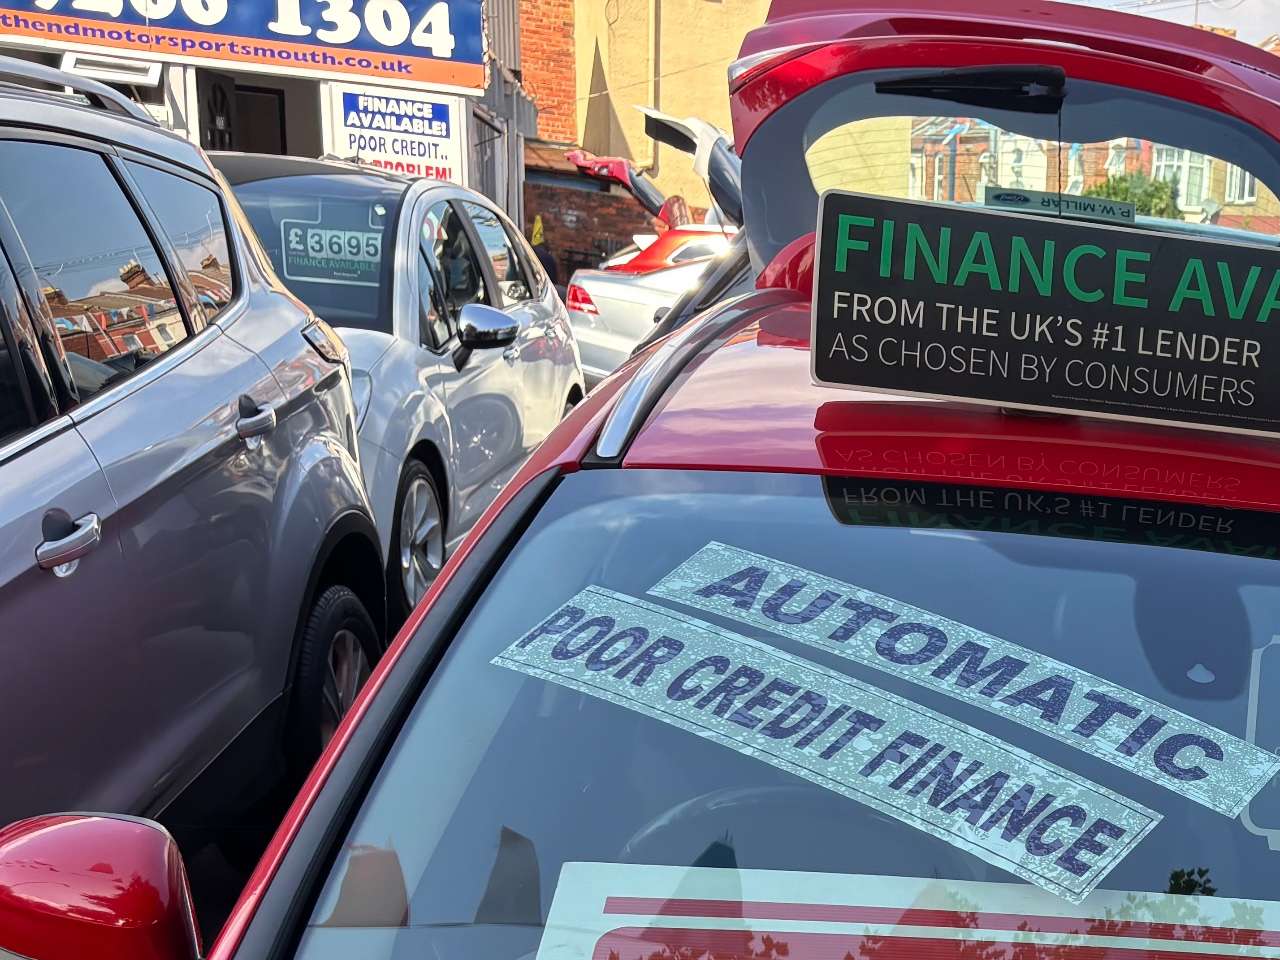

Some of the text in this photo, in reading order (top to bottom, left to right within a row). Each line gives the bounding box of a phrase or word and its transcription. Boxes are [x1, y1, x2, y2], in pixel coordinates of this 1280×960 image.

[358, 95, 433, 119] FINANCE
[346, 111, 447, 137] AVAILABLE!
[349, 133, 387, 154] POOR
[1040, 197, 1096, 213] MILLAR
[289, 228, 379, 257] £3695
[288, 256, 327, 268] FINANCE
[834, 212, 1152, 309] FINANCE
[833, 290, 1261, 369] FROM THE UK'S #1 LENDER
[829, 332, 1256, 407] AS CHOSEN BY CONSUMERS
[695, 564, 1225, 784] AUTOMATIC
[517, 603, 1127, 878] POOR CREDIT FINANCE
